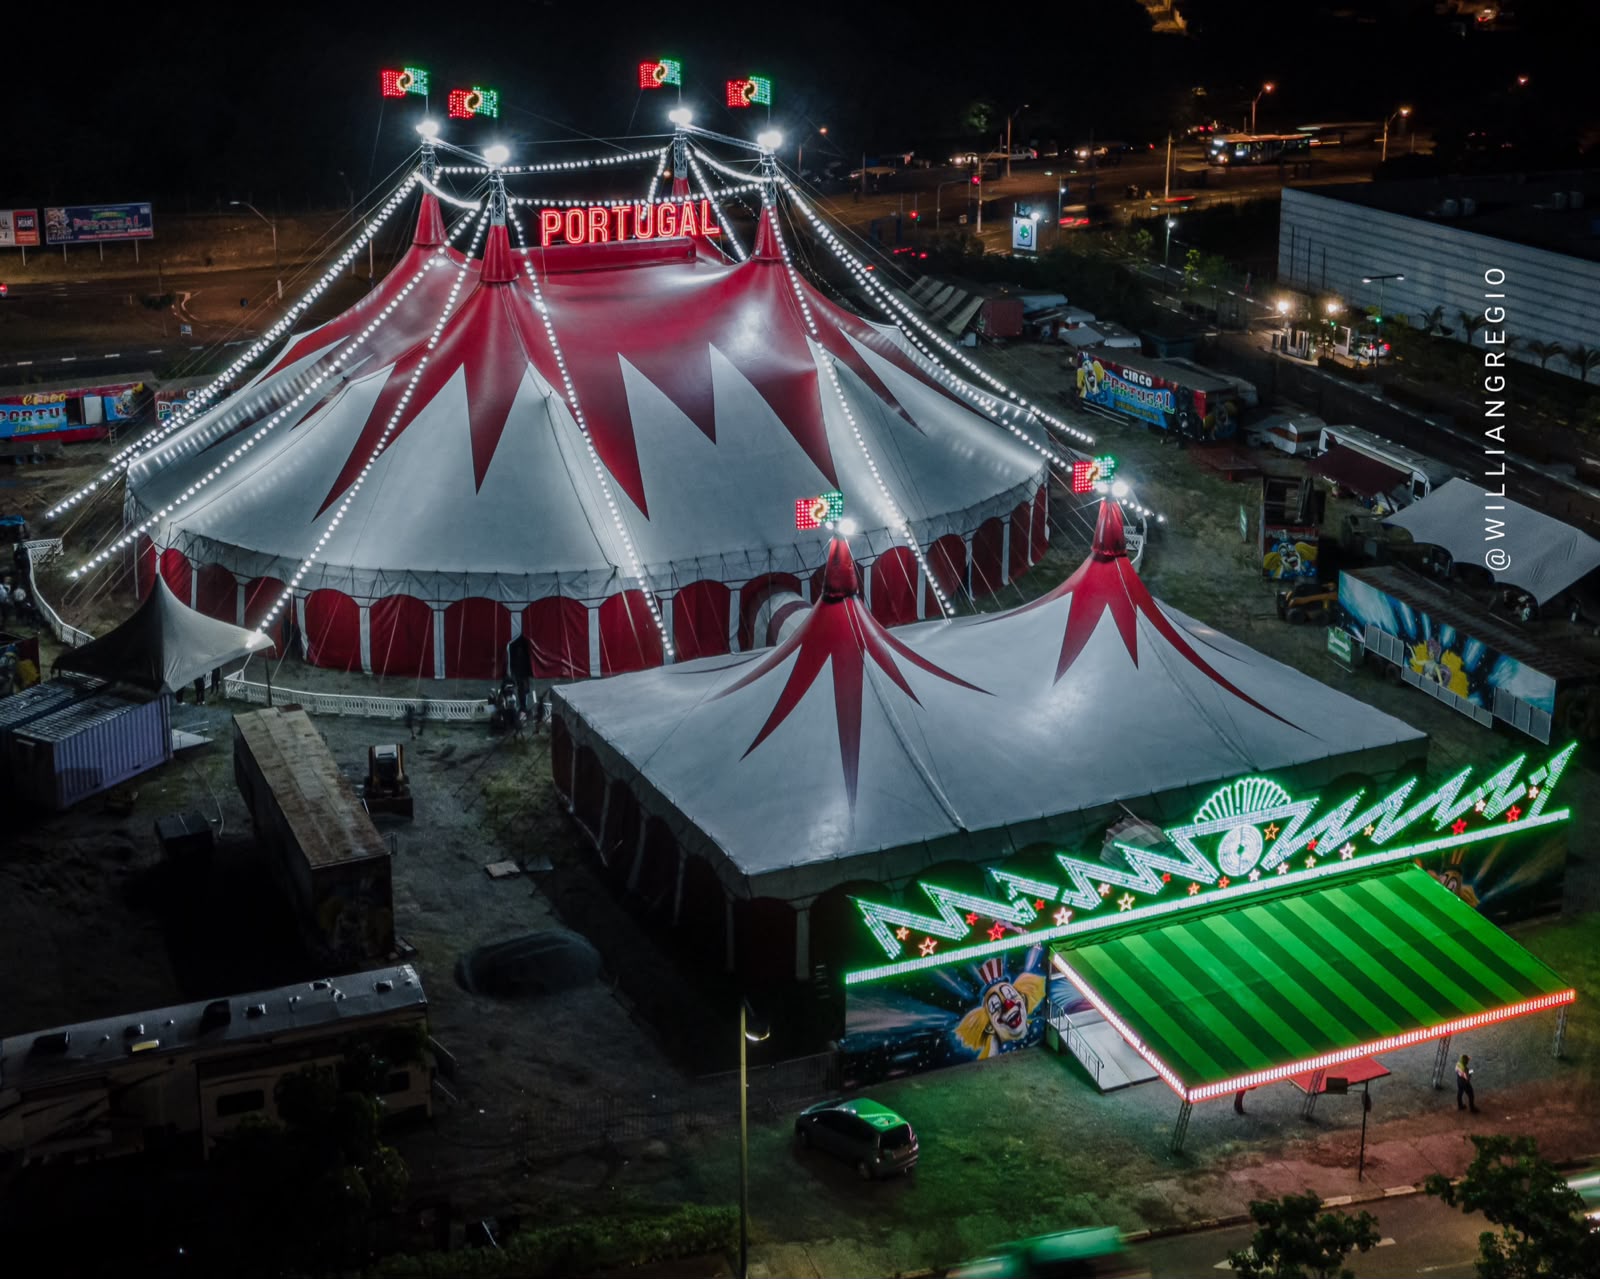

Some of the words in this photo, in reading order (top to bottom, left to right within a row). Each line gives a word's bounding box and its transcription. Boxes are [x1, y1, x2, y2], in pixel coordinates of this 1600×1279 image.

[540, 199, 721, 247] PORTUGAL
[1103, 371, 1175, 415] PORTUGAL
[1122, 368, 1153, 387] CIRCO
